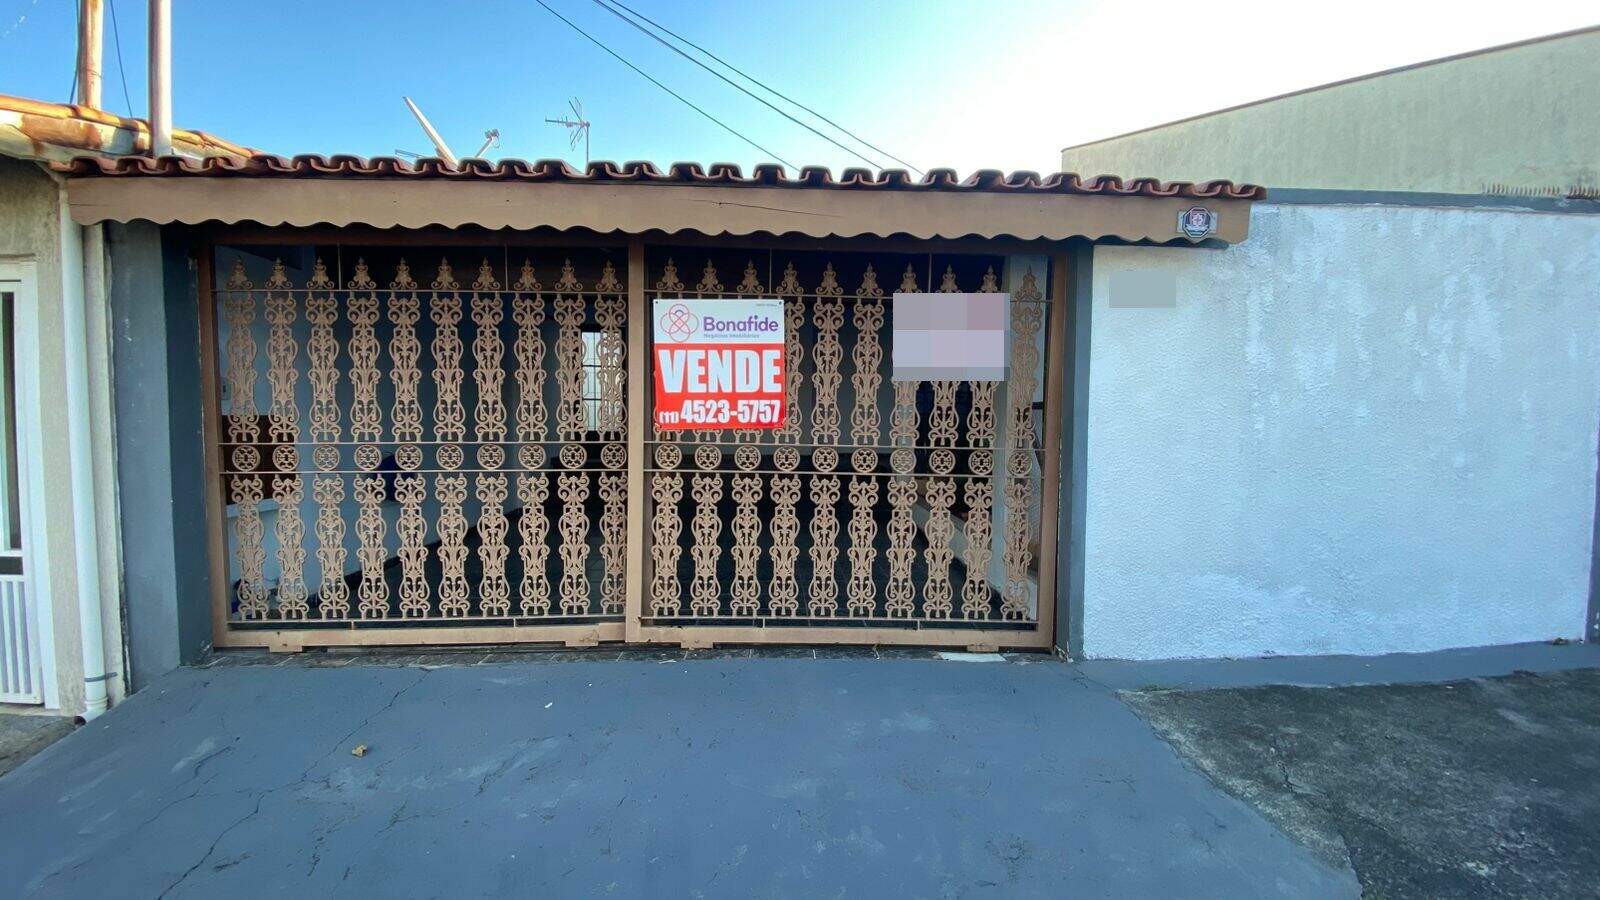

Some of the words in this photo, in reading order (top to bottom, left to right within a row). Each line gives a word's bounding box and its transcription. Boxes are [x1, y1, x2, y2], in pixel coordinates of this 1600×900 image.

[703, 315, 779, 332] Bonafide
[658, 349, 782, 393] VENDE
[659, 411, 679, 423] (11)
[681, 399, 780, 423] 4523-5757
